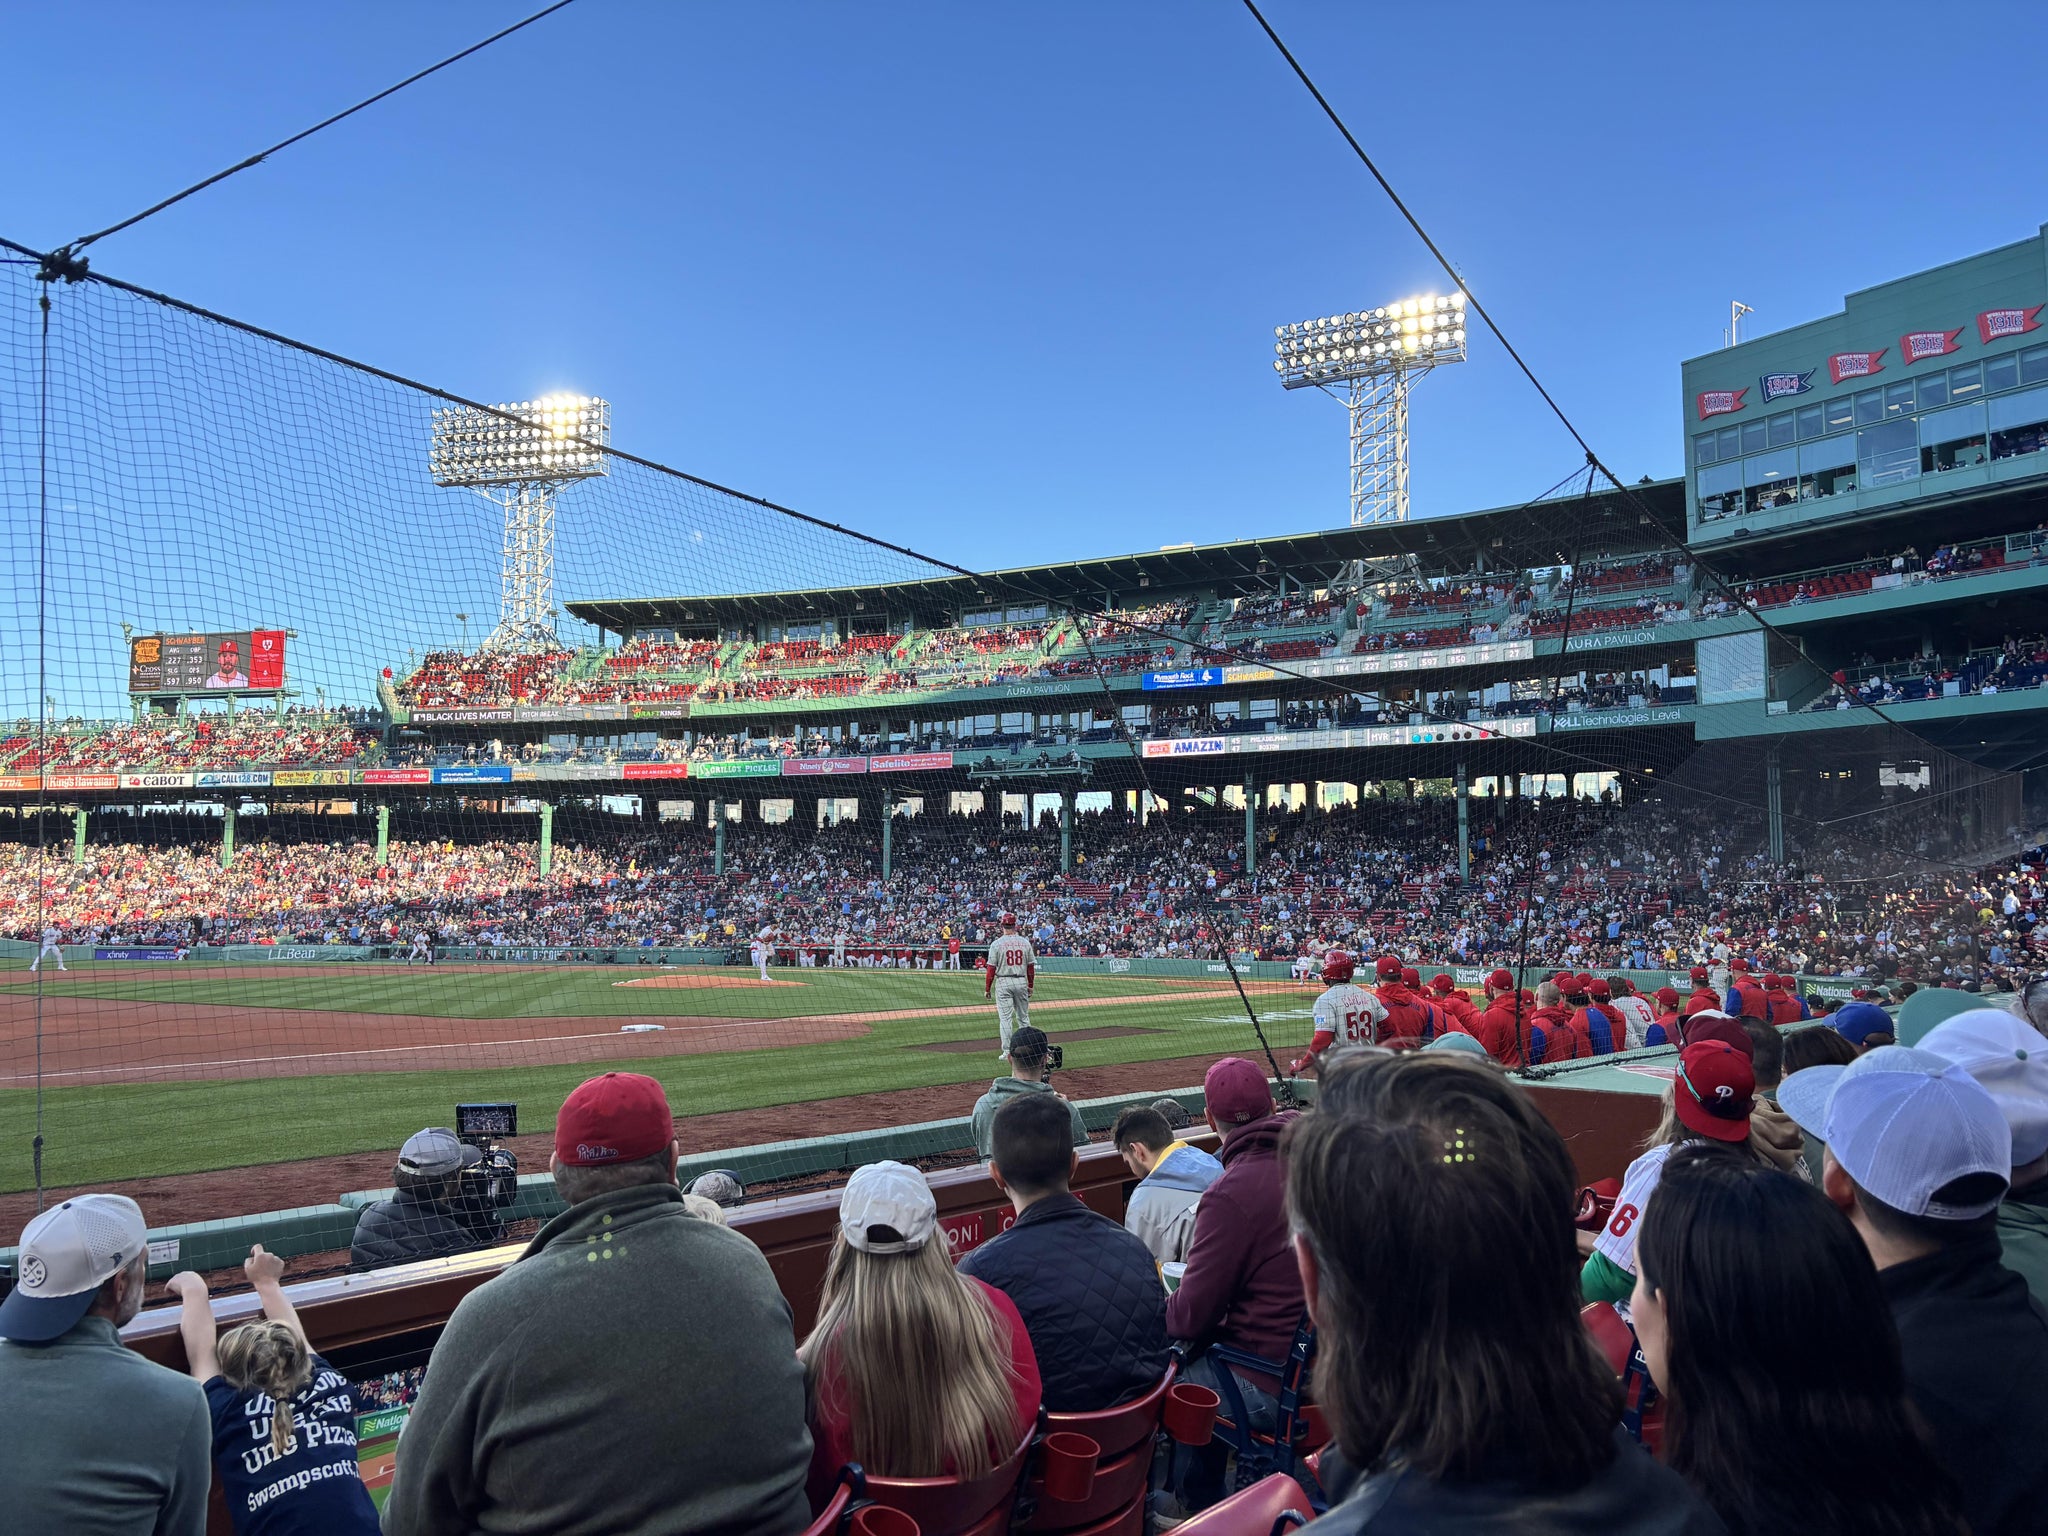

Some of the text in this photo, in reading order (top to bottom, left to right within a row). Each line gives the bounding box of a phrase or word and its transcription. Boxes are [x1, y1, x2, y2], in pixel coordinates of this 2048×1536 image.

[1988, 315, 2024, 331] 1916
[1911, 337, 1944, 351] 1915
[1838, 358, 1868, 372] 1912
[1767, 378, 1799, 392] 1904
[1704, 396, 1733, 409] 1903
[1605, 632, 1655, 645] PAVILION
[165, 657, 181, 665] .227
[1390, 661, 1408, 669] .353
[1419, 658, 1437, 666] .597
[1448, 656, 1466, 664] .950
[1362, 662, 1379, 671] .227
[1228, 671, 1274, 680] SCHWARBER
[164, 678, 180, 686] .597
[185, 677, 202, 685] .950
[1034, 684, 1070, 693] PAVILION
[426, 711, 511, 721] BLACK LIVES MATTER
[1581, 713, 1649, 727] Technologies
[1652, 708, 1680, 720] Level
[711, 764, 776, 773] GRILLO'S PICKLES
[800, 763, 821, 771] Ninety
[75, 776, 115, 788] Hawaiian
[221, 774, 269, 784] CALL128.COM
[107, 950, 129, 960] xfinity
[1006, 949, 1023, 966] 88
[1456, 968, 1479, 977] Ninety
[1457, 975, 1479, 983] Nine
[1816, 985, 1854, 998] National
[1346, 1010, 1372, 1040] 53
[1715, 1085, 1734, 1103] P
[376, 1414, 404, 1430] Natio
[304, 1420, 357, 1448] Pizza
